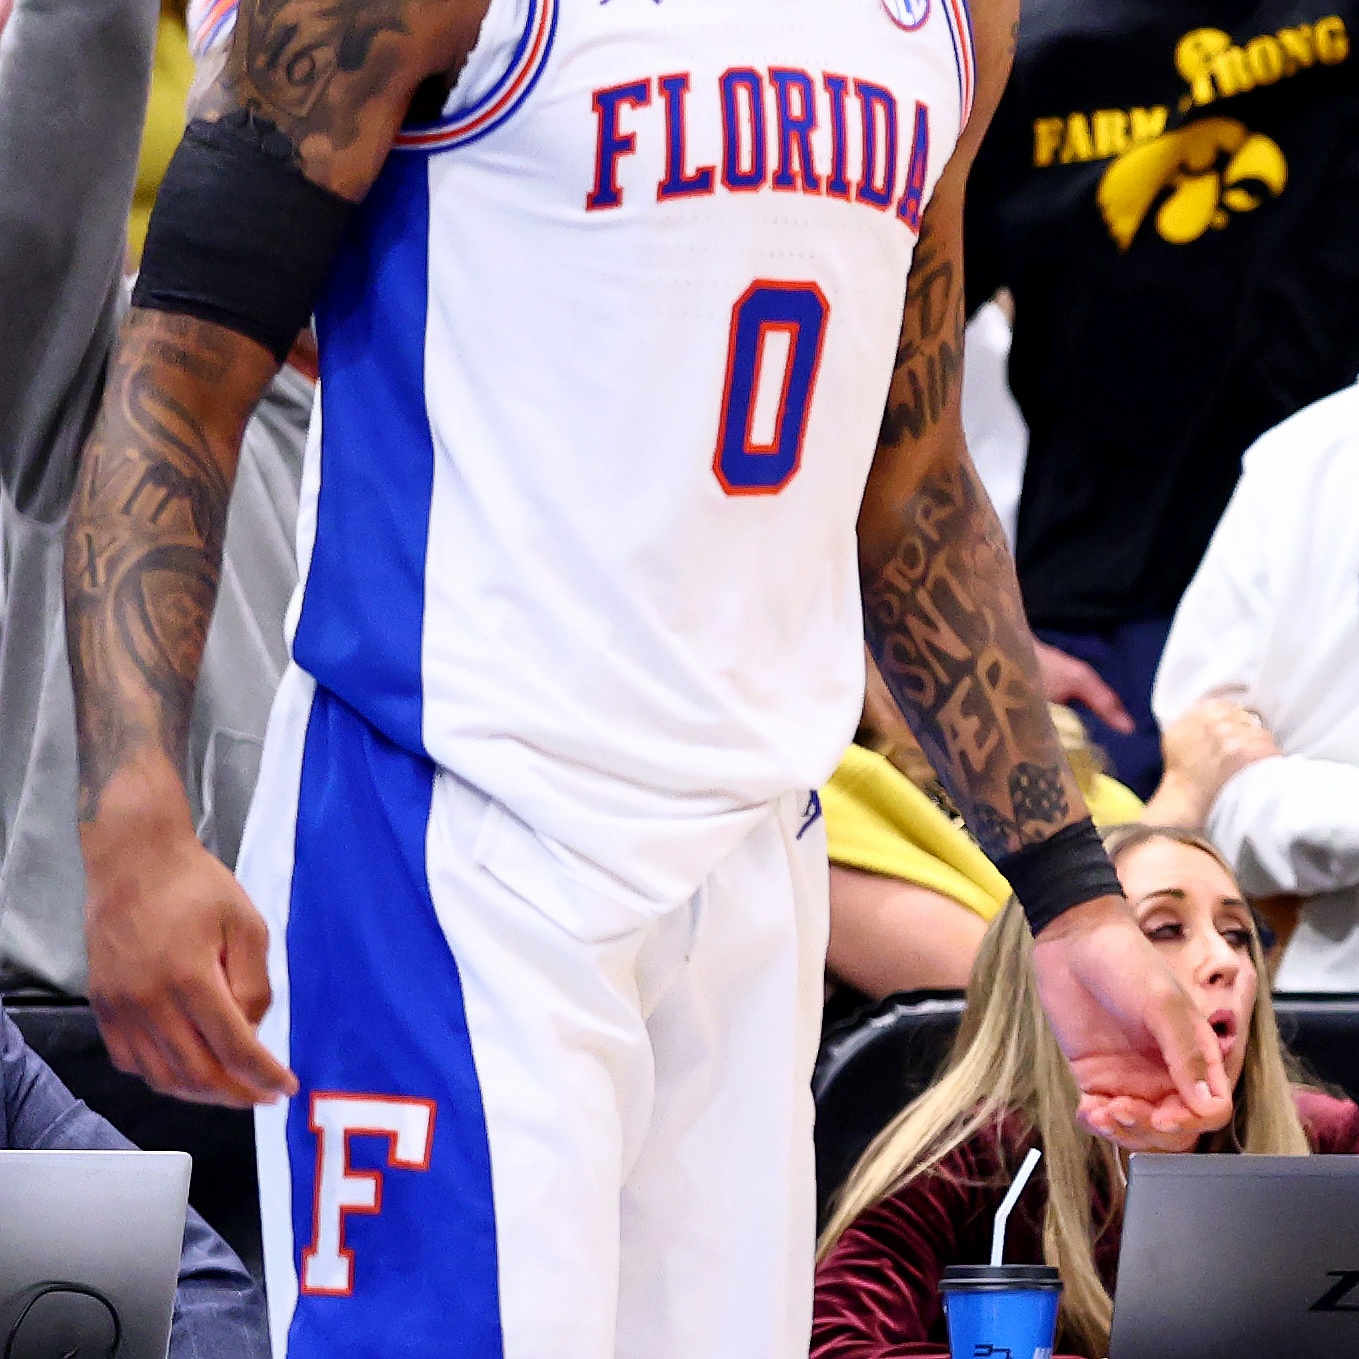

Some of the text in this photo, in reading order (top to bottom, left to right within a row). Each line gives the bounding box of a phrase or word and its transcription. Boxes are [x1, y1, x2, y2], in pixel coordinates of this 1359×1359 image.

[585, 66, 929, 236] FLORIDA
[713, 279, 831, 497] 0
[301, 1091, 437, 1297] F
